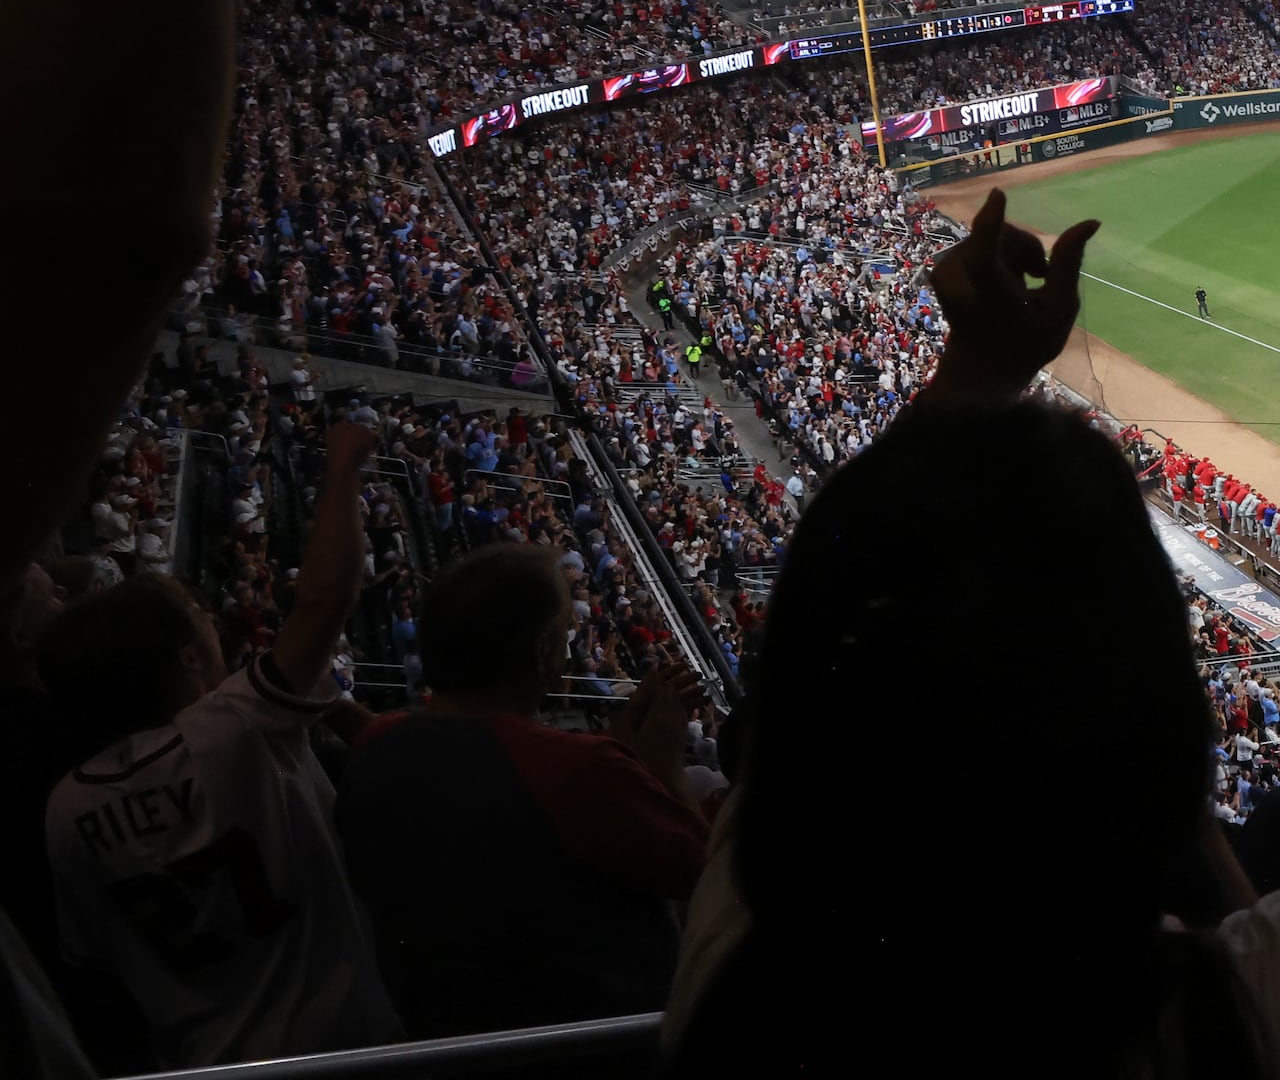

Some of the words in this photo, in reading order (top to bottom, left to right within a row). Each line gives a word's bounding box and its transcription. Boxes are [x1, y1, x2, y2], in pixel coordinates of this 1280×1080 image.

[700, 50, 754, 78] STRIKEOUT
[522, 85, 590, 118] STRIKEOUT
[960, 93, 1039, 126] STRIKEOUT
[1079, 103, 1110, 119] MLB+
[1018, 114, 1050, 132] MLB+
[1056, 135, 1078, 146] SOUTH
[1056, 140, 1085, 153] COLLEGE
[75, 778, 193, 856] RILEY
